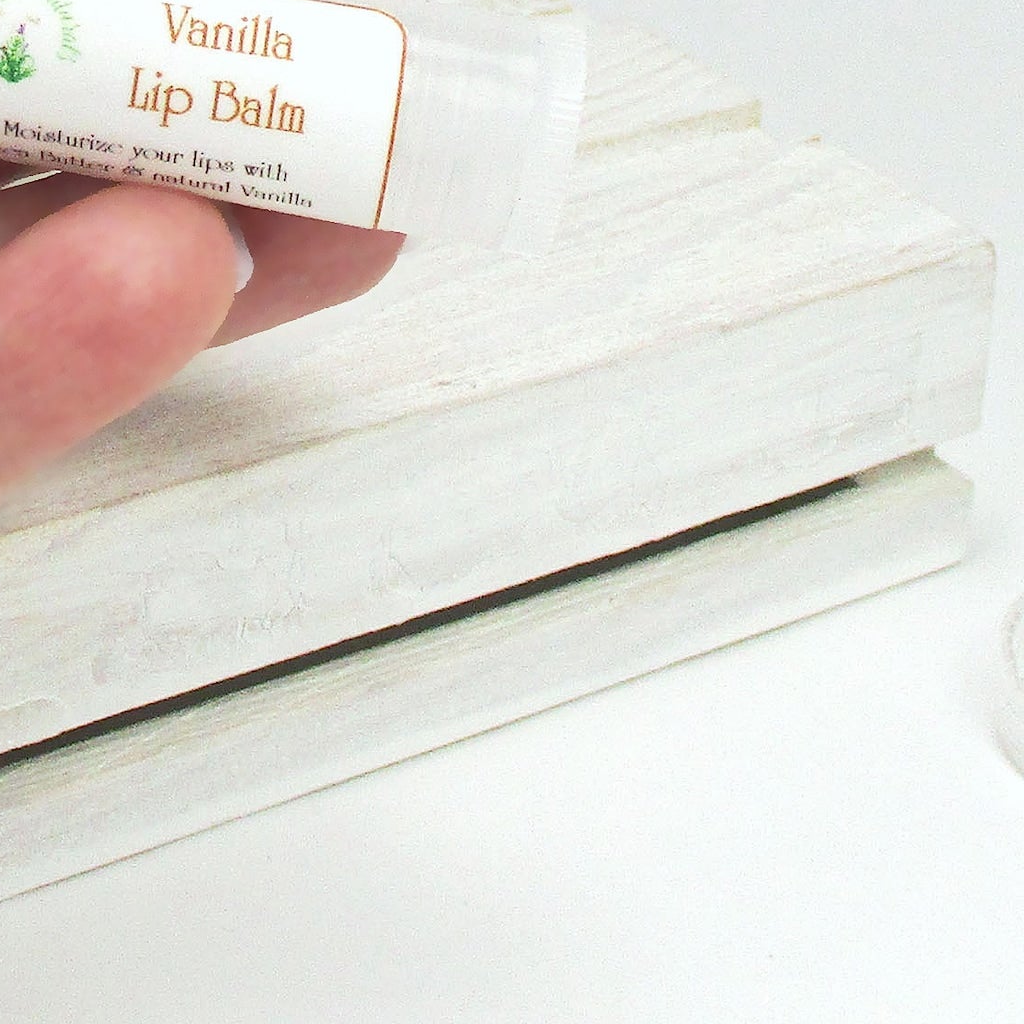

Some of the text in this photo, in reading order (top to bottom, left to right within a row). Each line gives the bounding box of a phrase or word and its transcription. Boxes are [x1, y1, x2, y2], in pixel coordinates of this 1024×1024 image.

[161, 1, 294, 62] Vanilla
[127, 65, 306, 134] Lip Balm
[3, 119, 288, 183] Moisturize your lips with
[39, 149, 115, 173] Butter
[152, 170, 230, 194] natural
[239, 183, 313, 209] Vanilla
